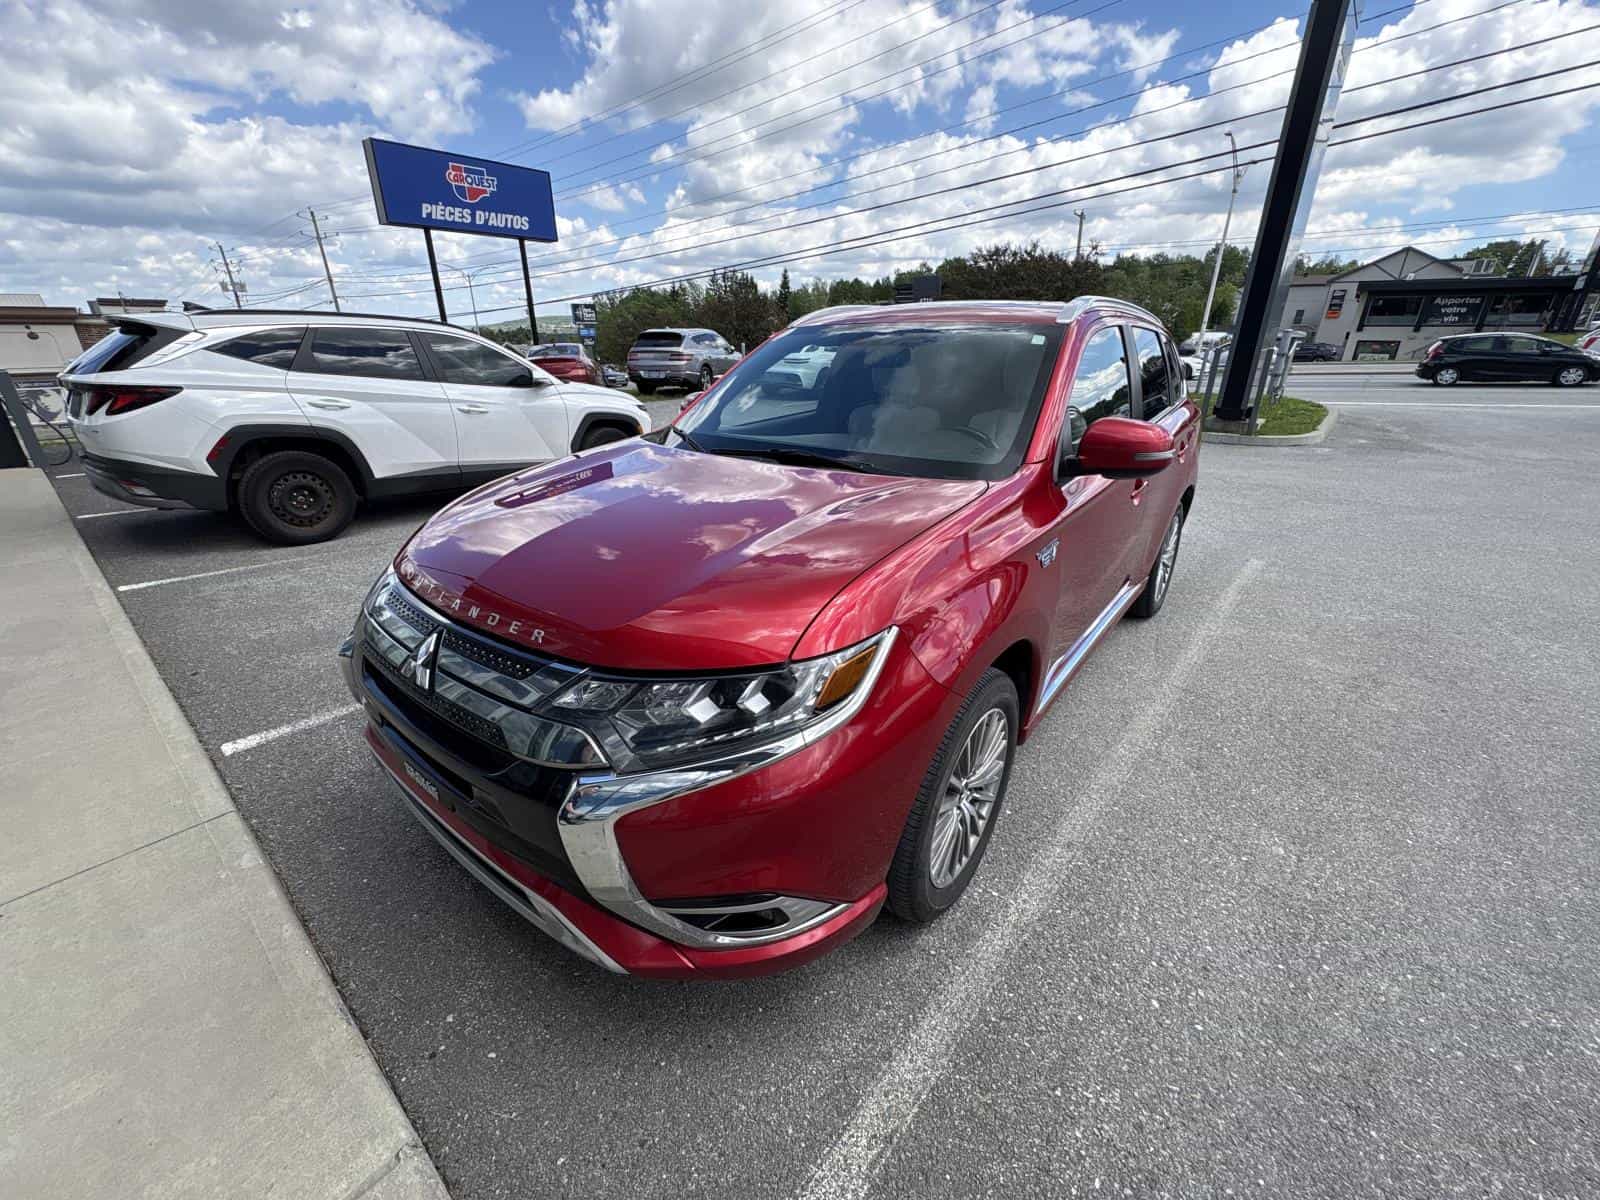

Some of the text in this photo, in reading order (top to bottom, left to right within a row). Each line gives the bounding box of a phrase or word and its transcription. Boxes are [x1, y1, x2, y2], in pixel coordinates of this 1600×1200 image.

[447, 172, 496, 190] CARQUEST
[421, 202, 529, 230] PIÈCES D'AUTOS
[1434, 297, 1481, 306] Apportez
[1443, 314, 1459, 322] vin
[406, 568, 545, 643] OUTLANDER
